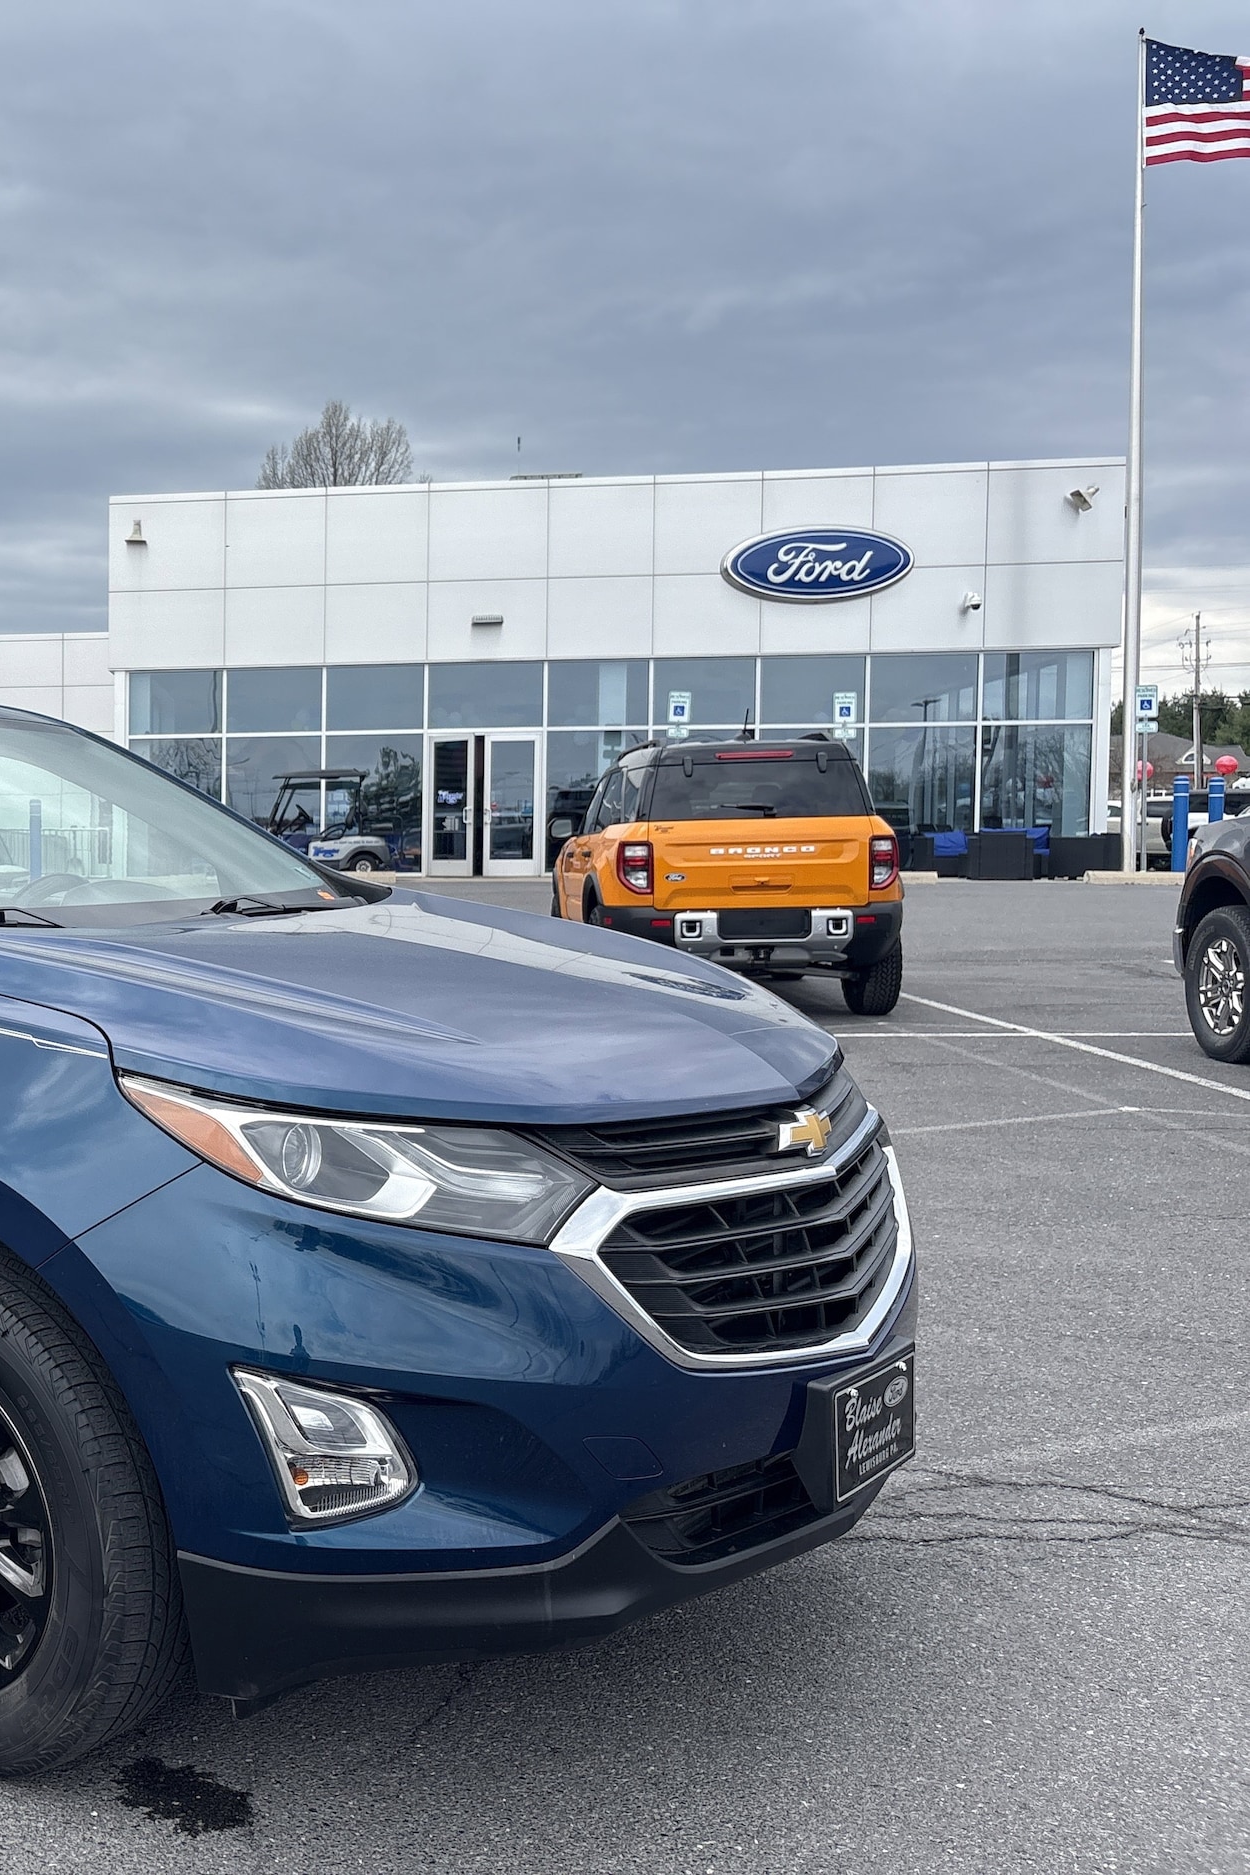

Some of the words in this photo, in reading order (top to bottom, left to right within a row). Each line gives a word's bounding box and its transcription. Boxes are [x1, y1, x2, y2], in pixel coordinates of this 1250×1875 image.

[766, 541, 874, 584] Ford
[709, 845, 816, 855] BRONCO
[844, 1396, 883, 1432] Blaise
[844, 1412, 902, 1470] Alexander
